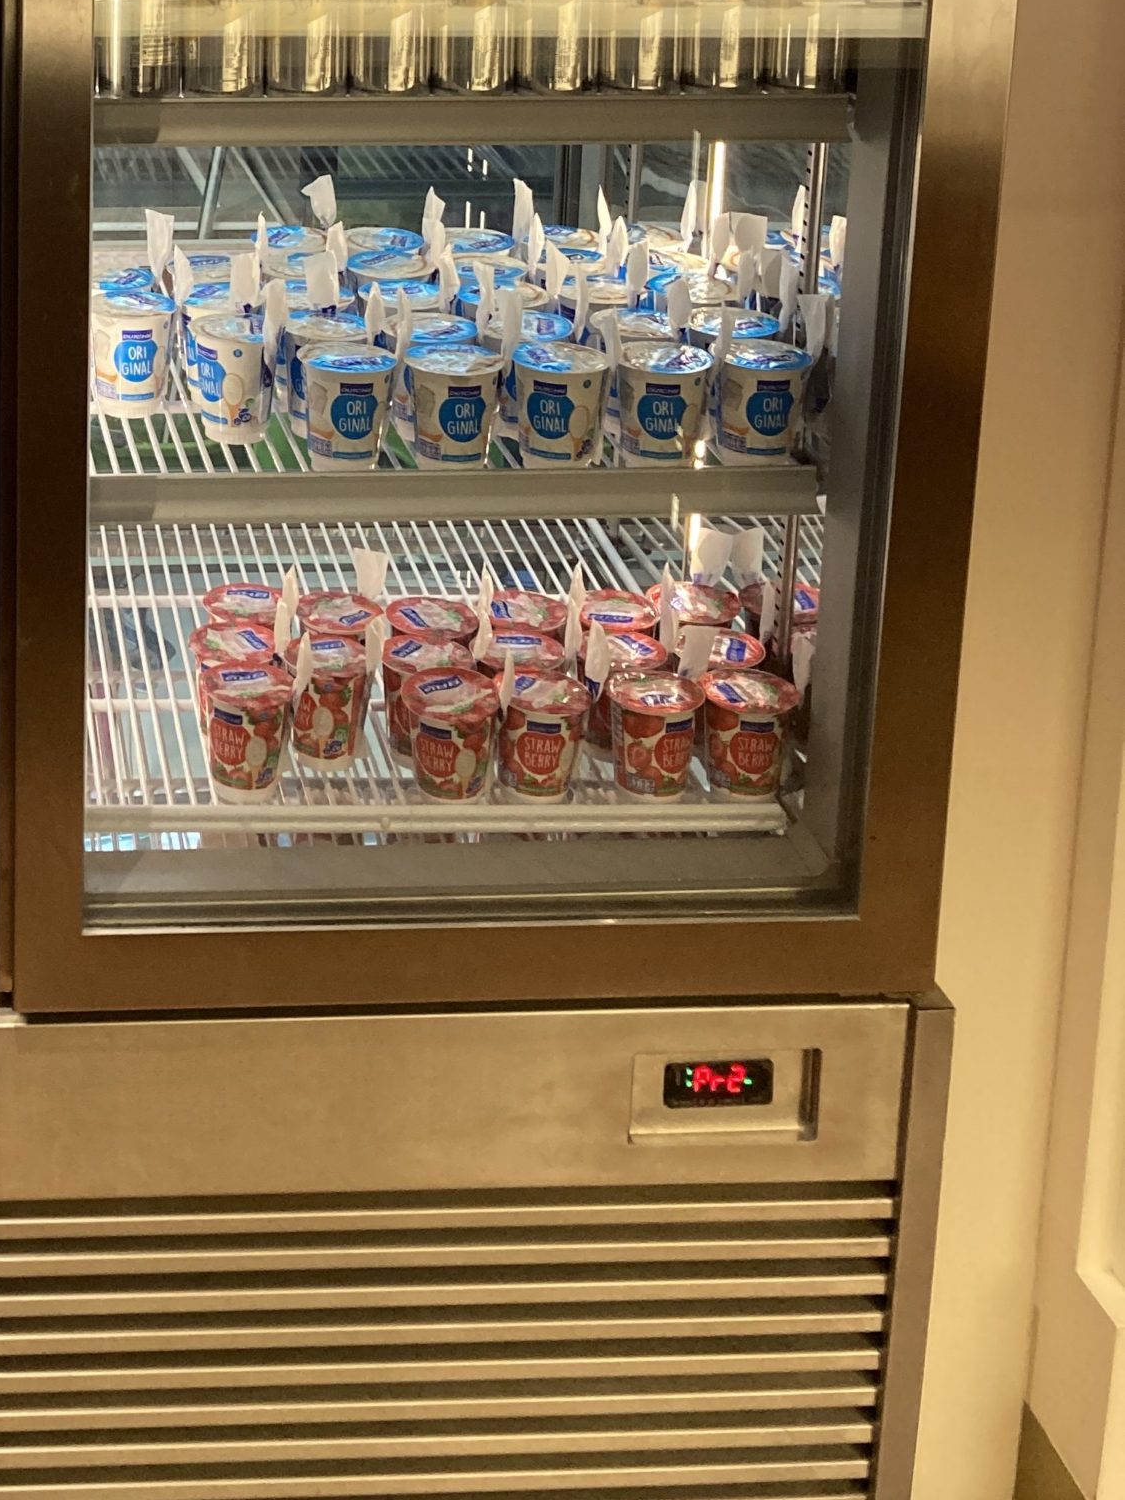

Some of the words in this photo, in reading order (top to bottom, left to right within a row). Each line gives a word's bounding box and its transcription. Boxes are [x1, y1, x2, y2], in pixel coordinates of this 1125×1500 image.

[128, 346, 147, 361] ORI
[121, 362, 152, 376] GINAL
[346, 401, 367, 416] ORI
[454, 403, 475, 418] ORI
[539, 400, 561, 415] ORI
[652, 400, 674, 416] ORI
[763, 399, 783, 414] ORI
[339, 417, 371, 433] GINAL
[447, 417, 480, 434] GINAL
[533, 415, 567, 433] GINAL
[754, 412, 787, 429] GINAL
[525, 738, 562, 754] STRAW
[524, 752, 559, 769] BERRY
